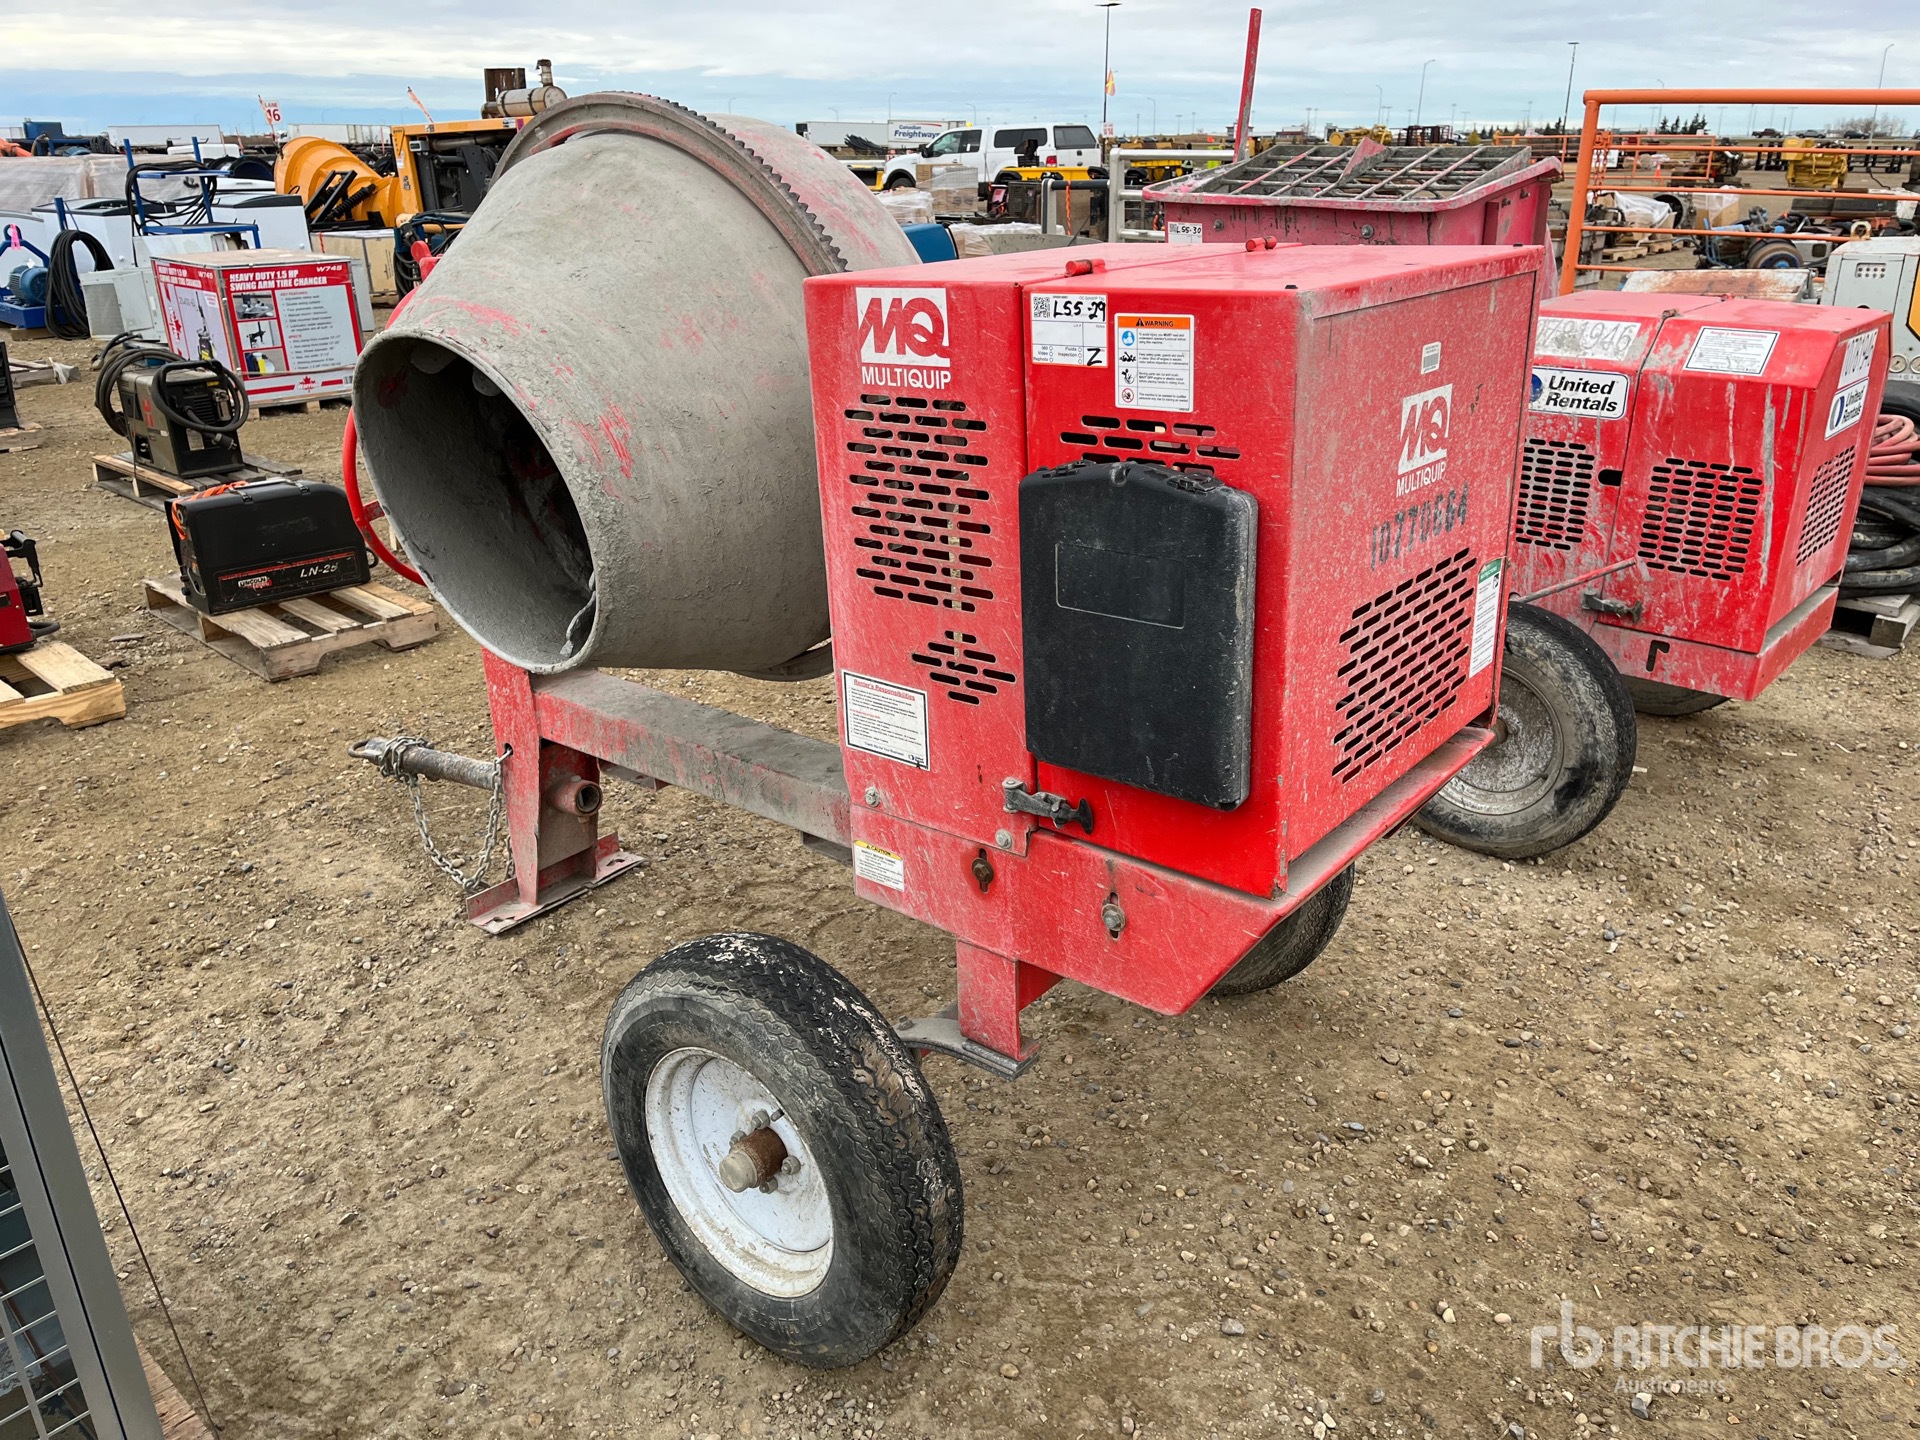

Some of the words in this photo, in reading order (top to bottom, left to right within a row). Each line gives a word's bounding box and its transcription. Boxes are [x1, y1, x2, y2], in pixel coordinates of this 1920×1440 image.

[198, 271, 214, 279] W745
[230, 272, 254, 282] HEAVY
[255, 271, 275, 280] DUTY
[277, 270, 287, 279] 1.5
[288, 270, 298, 278] HP
[230, 281, 256, 291] SWING
[258, 280, 275, 289] ARM
[276, 279, 293, 287] TIRE
[294, 276, 327, 286] CHANGER
[861, 366, 952, 390] MULTIQUIP
[1548, 376, 1616, 395] United
[1546, 392, 1618, 412] Rentals
[1400, 395, 1449, 462] MQ
[1396, 461, 1446, 498] MULTIQUIP
[300, 562, 338, 578] LN-25
[875, 685, 915, 701] Responsibilities
